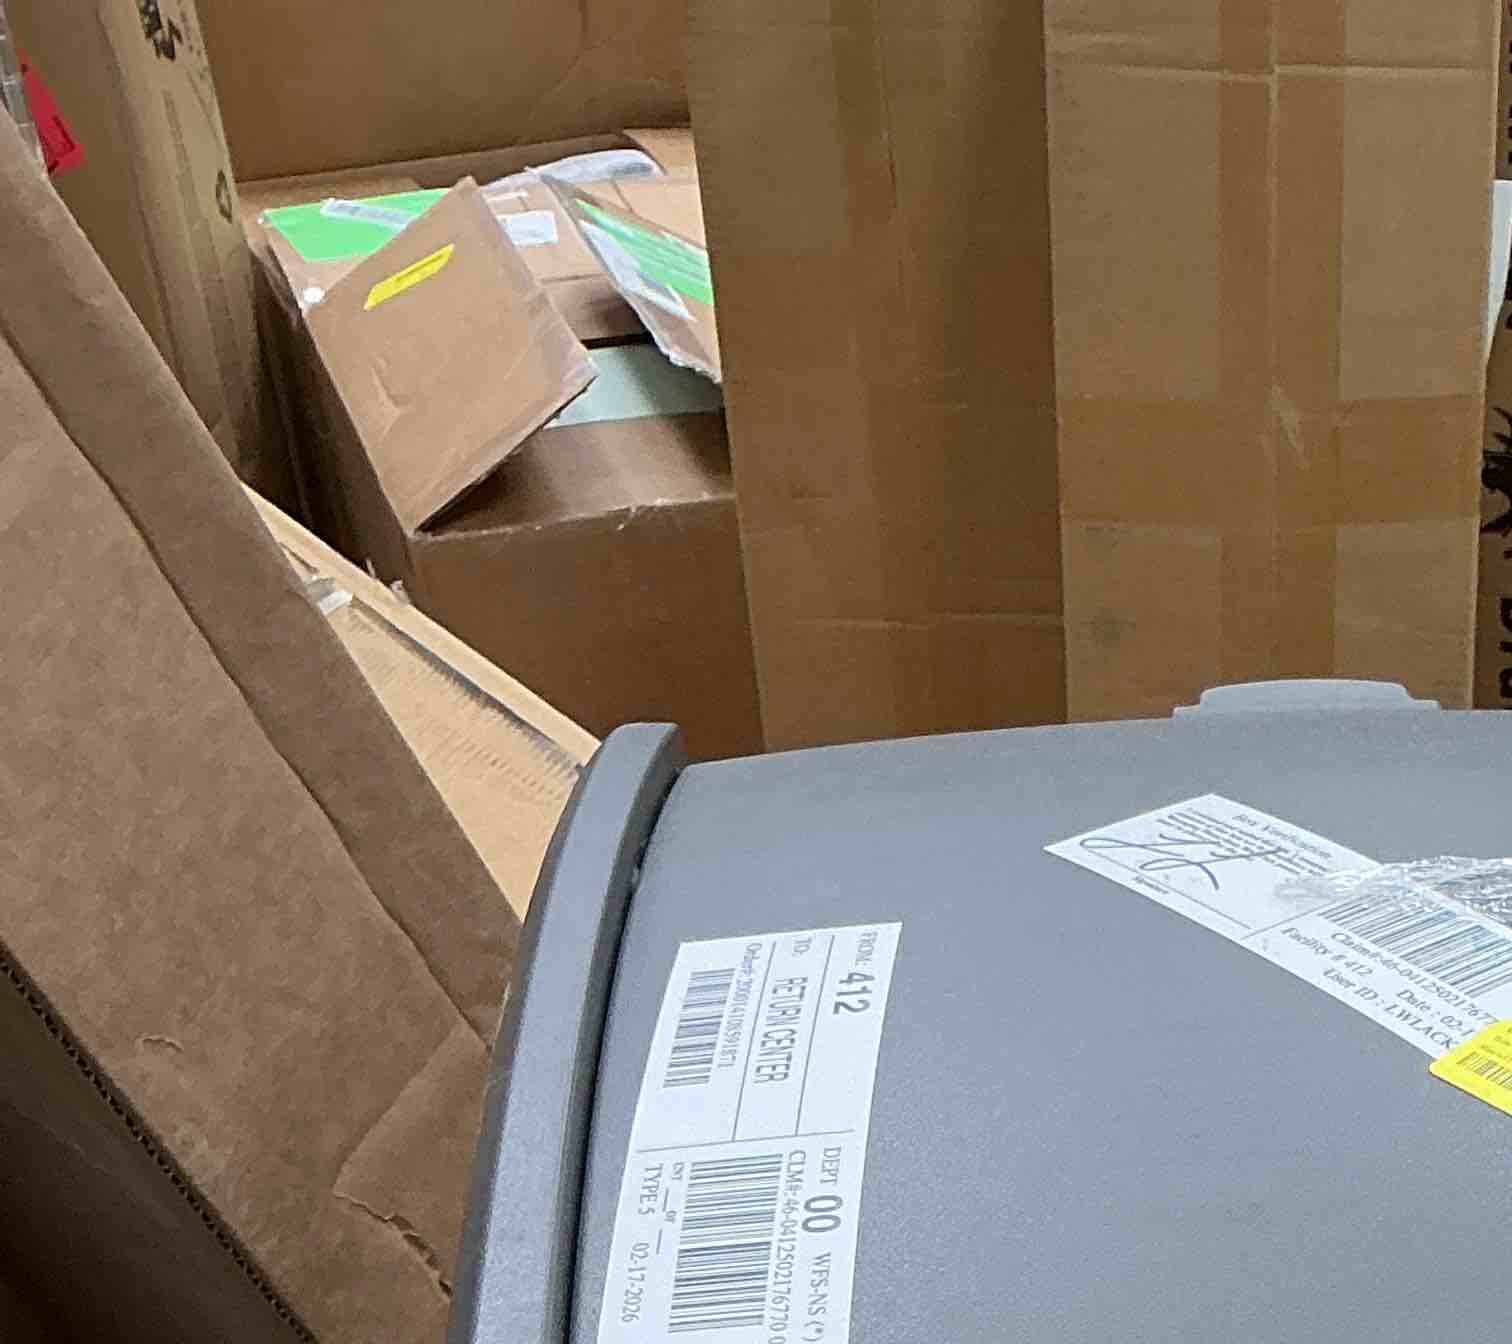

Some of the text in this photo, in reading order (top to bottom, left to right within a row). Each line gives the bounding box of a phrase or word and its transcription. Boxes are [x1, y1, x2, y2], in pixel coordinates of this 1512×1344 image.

[1281, 926, 1335, 957] Facility
[765, 976, 809, 1027] RETURN
[832, 971, 875, 1015] 412
[1359, 985, 1380, 1000] ID
[752, 1027, 799, 1085] CENTER
[640, 1162, 664, 1204] TYPE
[819, 1146, 842, 1185] DEPT
[801, 1194, 844, 1234] 00
[621, 1242, 651, 1323] 02-17-2026
